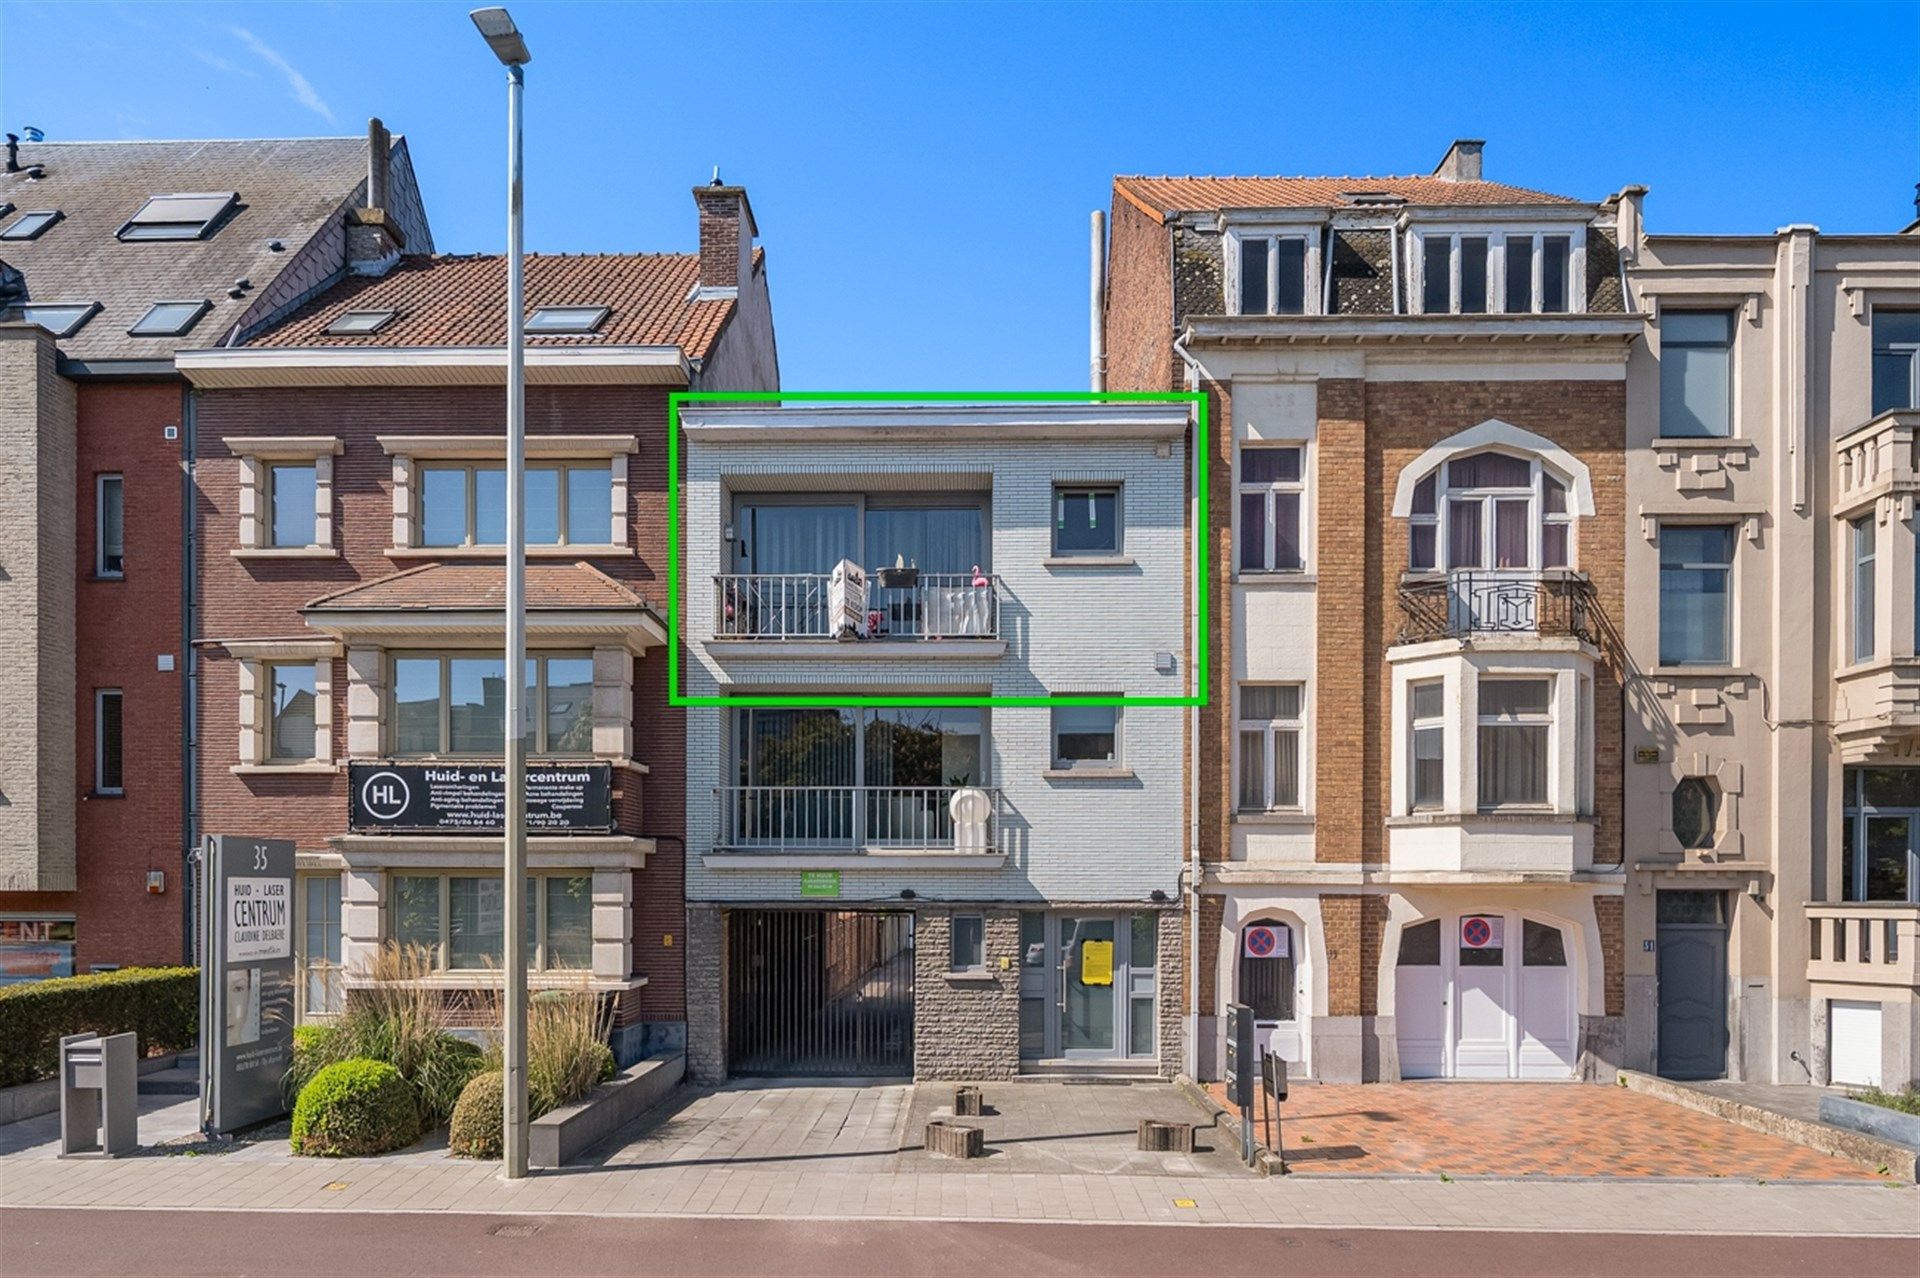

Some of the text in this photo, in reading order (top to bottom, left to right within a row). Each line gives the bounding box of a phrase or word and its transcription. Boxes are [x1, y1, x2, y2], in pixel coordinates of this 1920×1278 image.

[425, 770, 591, 782] Huid- en Larcentrum
[372, 785, 401, 804] HL
[253, 845, 268, 870] 35
[234, 884, 252, 896] HUID
[263, 884, 285, 896] LASER
[234, 900, 286, 927] CENTRUM
[234, 930, 260, 943] CLAUDINE
